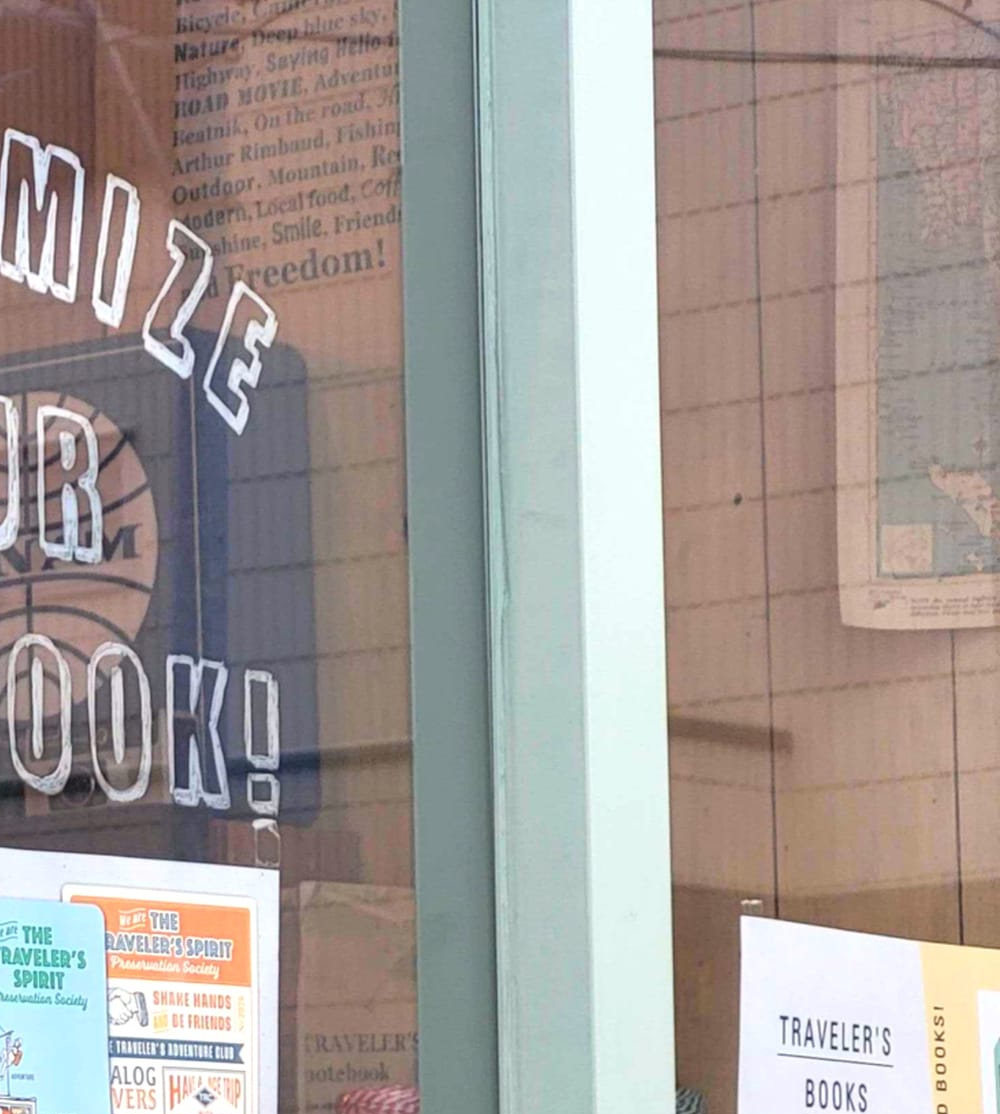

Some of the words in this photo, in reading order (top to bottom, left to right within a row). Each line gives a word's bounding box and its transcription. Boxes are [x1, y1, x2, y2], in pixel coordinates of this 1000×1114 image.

[252, 27, 298, 47] Deep
[265, 47, 329, 74] Saying
[174, 92, 229, 120] ROAD
[254, 113, 281, 132] On
[286, 106, 314, 127] the
[172, 149, 234, 177] Arthur
[256, 192, 303, 219] Local
[223, 238, 387, 293] Freedom!
[150, 911, 179, 931] THE
[22, 926, 53, 945] THE
[186, 938, 233, 959] SPIRIT
[111, 955, 180, 973] Preservation
[183, 962, 220, 980] Society
[13, 970, 65, 990] SPIRIT
[55, 993, 88, 1011] Society
[153, 990, 190, 1006] SHAKE
[193, 993, 232, 1010] HANDS
[188, 1014, 232, 1031] FRIENDS
[779, 1015, 892, 1056] TRAVELER'S
[116, 1040, 166, 1056] TRAVELER'S
[168, 1043, 213, 1058] ADVENTURE
[215, 1046, 235, 1060] CLUB
[933, 1005, 947, 1092] BOOKS!
[111, 1065, 156, 1086] ALOG
[111, 1088, 157, 1110] VERS
[805, 1078, 868, 1113] BOOKS
